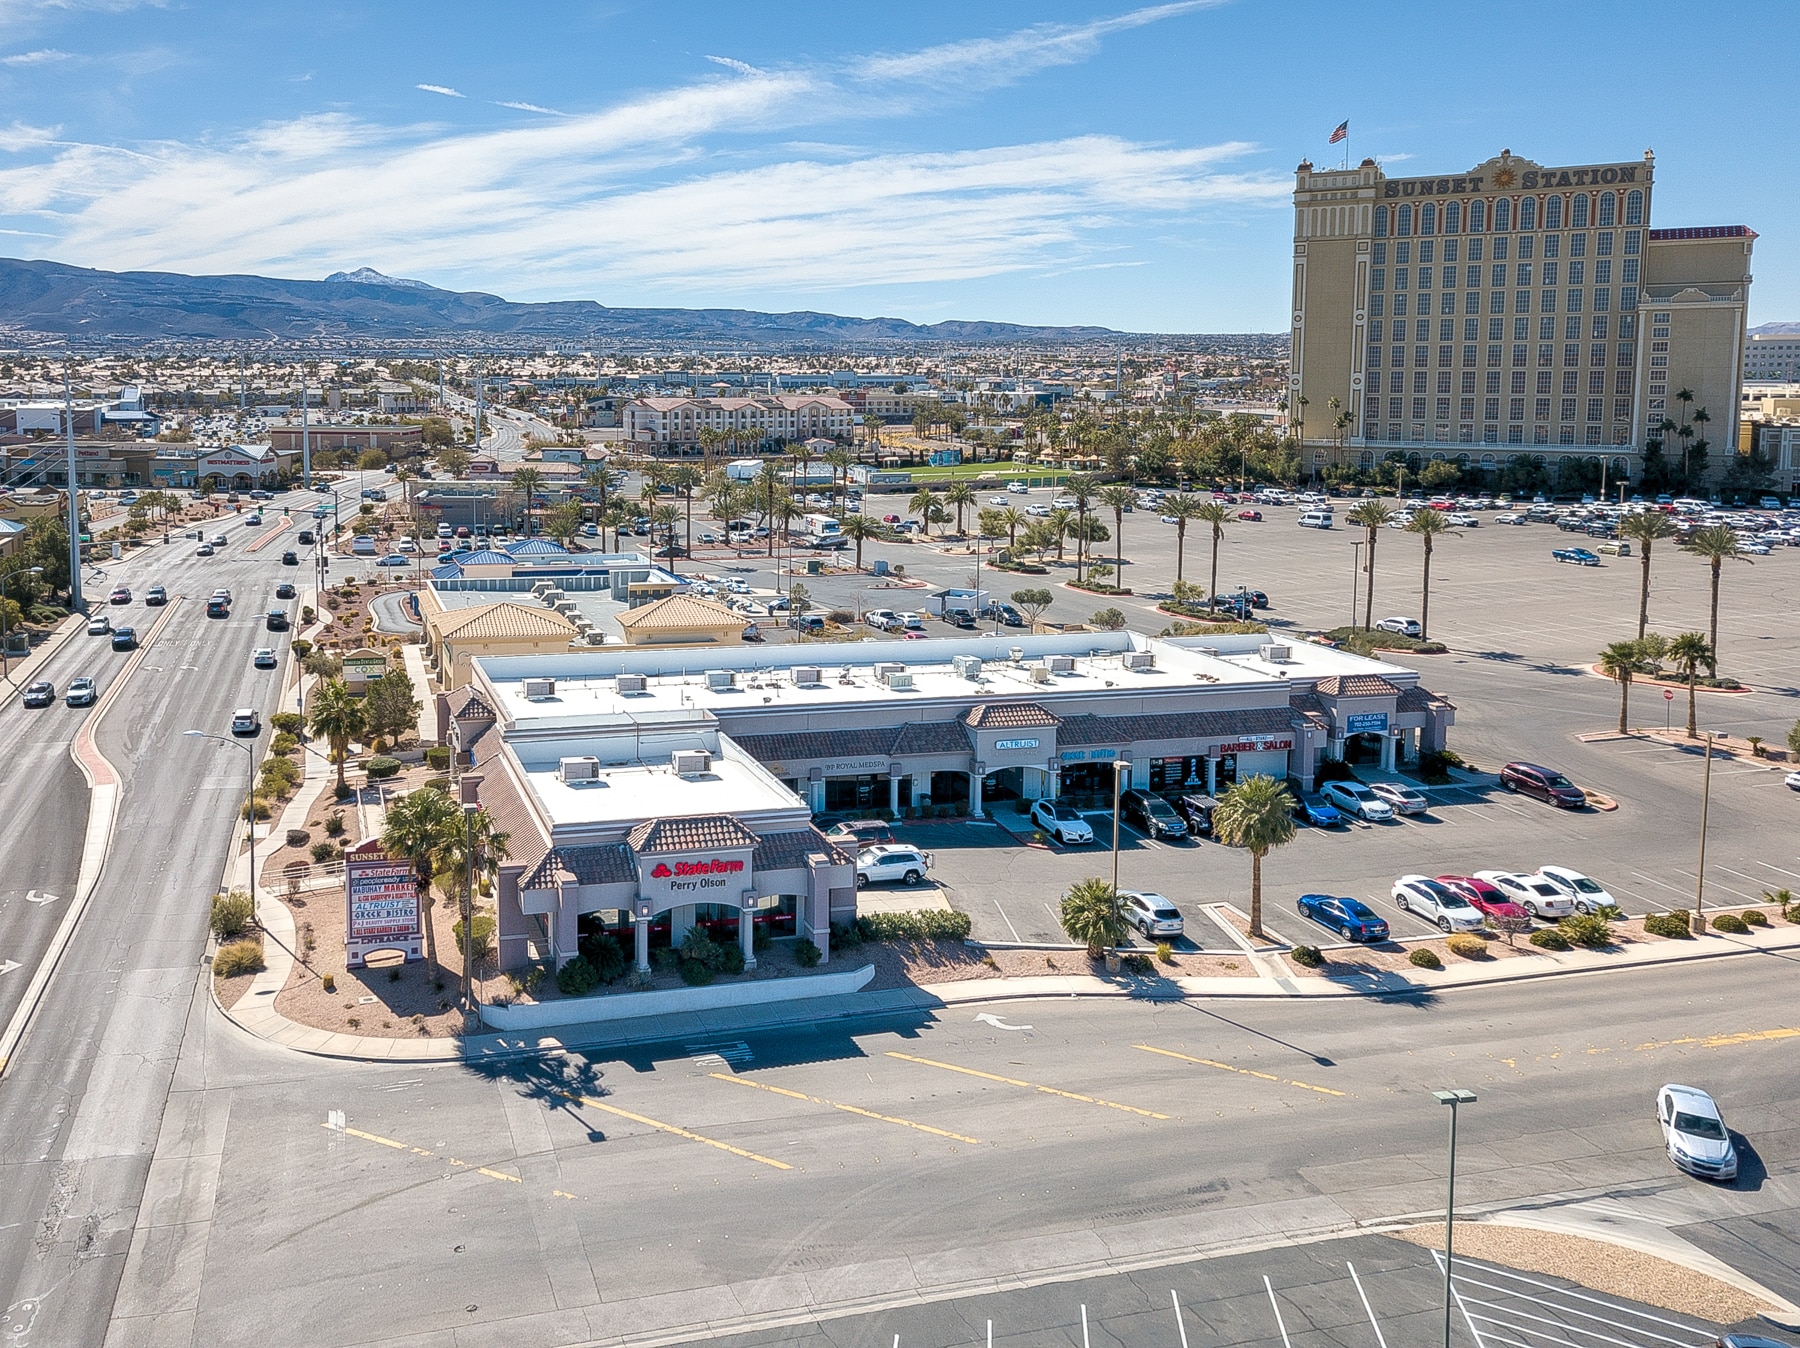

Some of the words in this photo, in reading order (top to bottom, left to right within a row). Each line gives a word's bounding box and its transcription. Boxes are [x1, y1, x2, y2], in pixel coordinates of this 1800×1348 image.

[1384, 177, 1483, 199] SUNSET
[1522, 166, 1637, 190] STATION
[1364, 713, 1386, 721] LEASE
[999, 739, 1038, 749] ALTRUIST
[1220, 741, 1256, 753] BARBER
[1256, 741, 1262, 751] &
[1263, 740, 1292, 750] SALON
[836, 762, 857, 770] ROYAL
[858, 760, 886, 769] MEDSPA
[350, 852, 385, 861] SUNSET
[360, 877, 400, 886] peopleready
[671, 880, 697, 891] Perry
[700, 878, 726, 889] Olson
[352, 885, 382, 894] MABUHAY
[384, 883, 415, 892] MARKET
[355, 900, 400, 910] ALTRUIST
[386, 909, 414, 917] BISTRO
[361, 935, 409, 945] ENTRANCE
